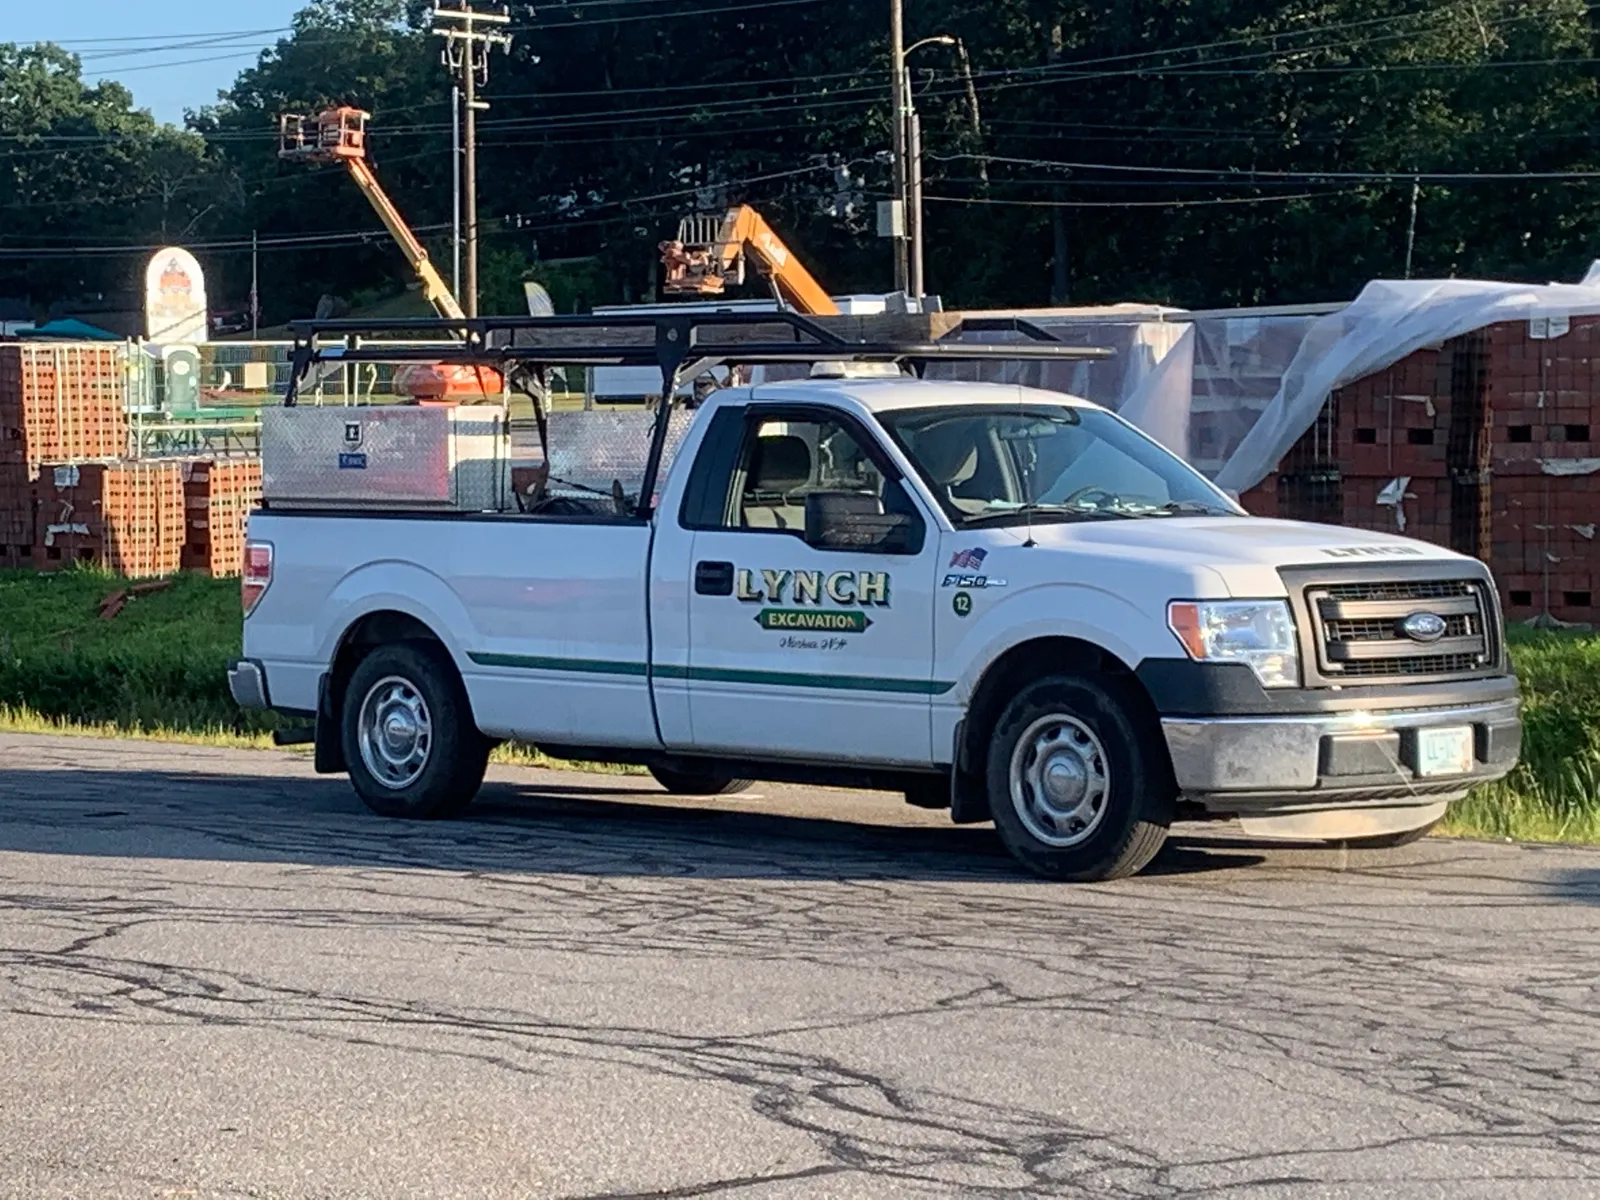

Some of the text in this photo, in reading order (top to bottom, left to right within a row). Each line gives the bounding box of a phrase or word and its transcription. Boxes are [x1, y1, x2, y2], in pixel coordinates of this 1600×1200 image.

[737, 568, 891, 607] LYNCH
[956, 597, 969, 611] 12
[768, 613, 856, 628] EXCAVATION
